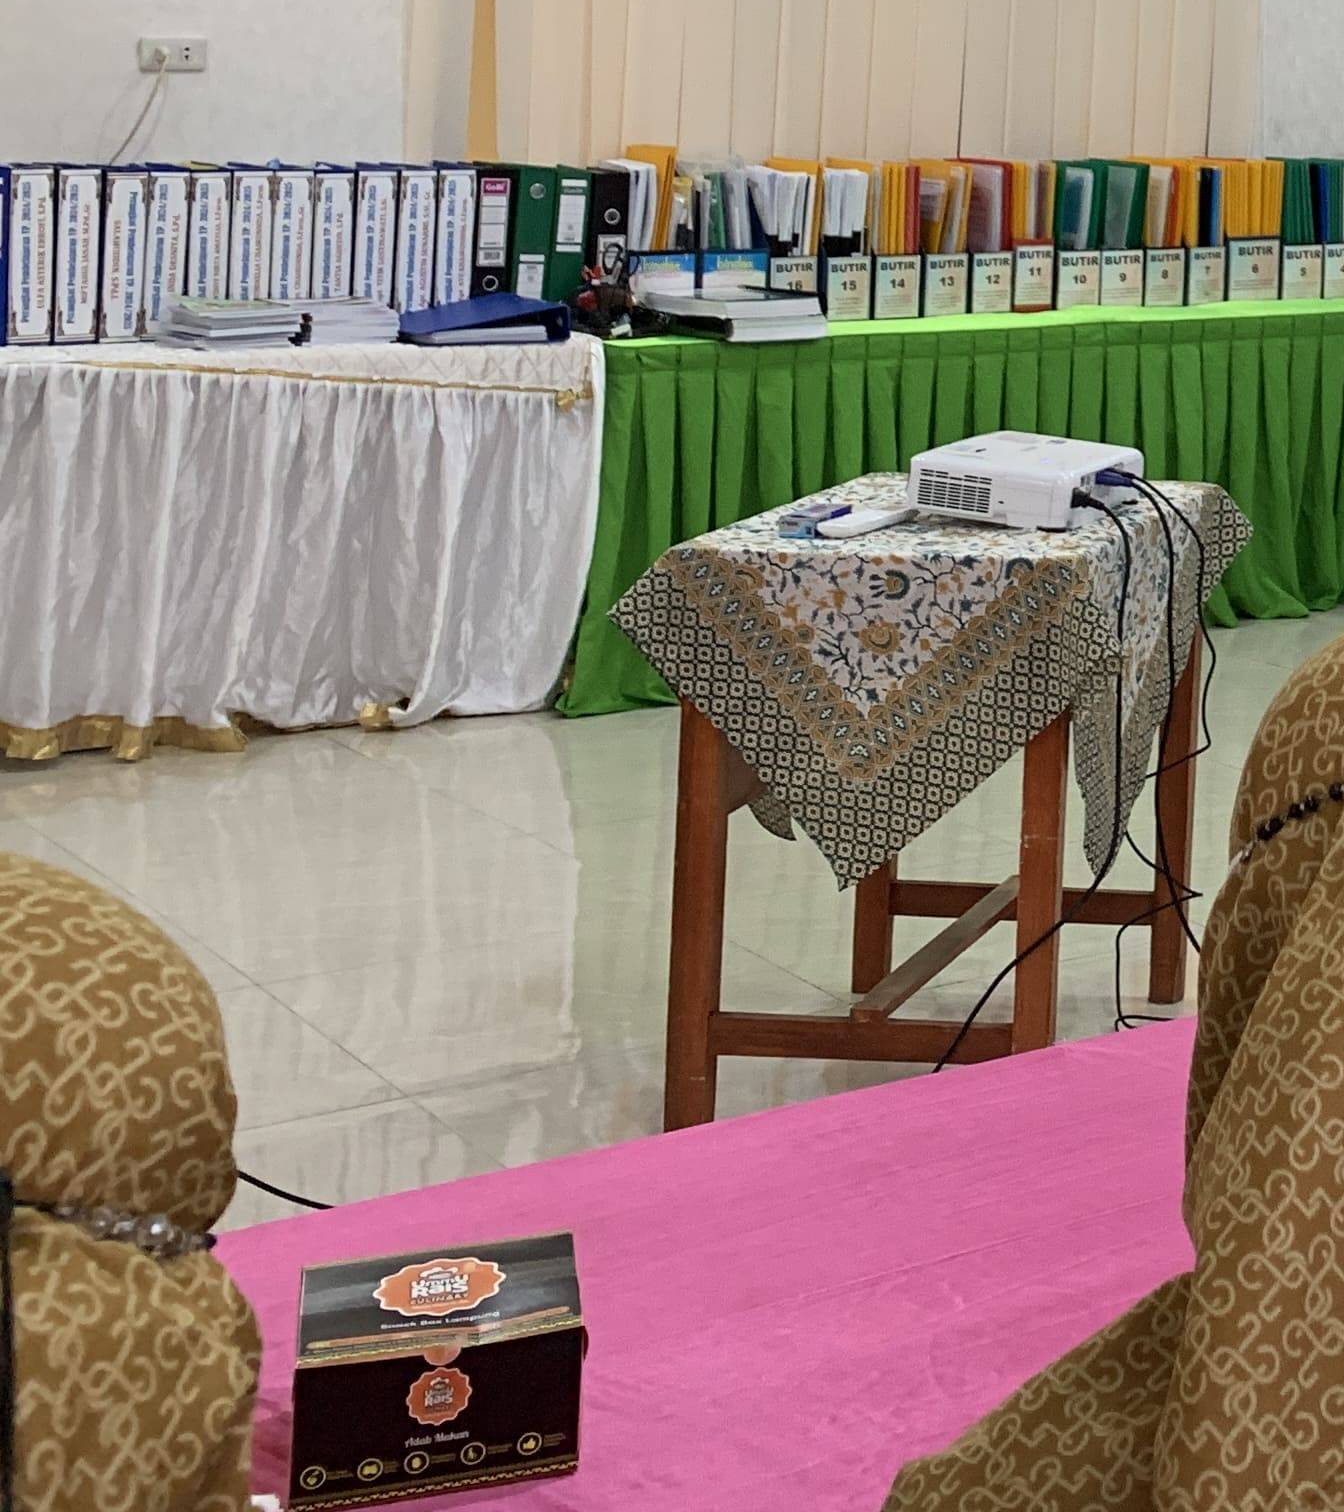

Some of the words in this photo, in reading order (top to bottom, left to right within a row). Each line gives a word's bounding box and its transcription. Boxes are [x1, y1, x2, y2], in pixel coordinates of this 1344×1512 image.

[1019, 250, 1051, 259] BUTIR
[1194, 252, 1222, 260] BUTIR
[1238, 246, 1273, 256] BUTIR
[1286, 249, 1321, 260] BUTIR
[976, 257, 1010, 268] BUTIR
[1062, 256, 1099, 266] BUTIR
[1104, 254, 1141, 265] BUTIR
[1150, 253, 1181, 263] BUTIR
[776, 263, 813, 273] BUTIR
[831, 263, 867, 273] BUTIR
[881, 261, 916, 271] BUTIR
[930, 259, 964, 270] BUTIR
[1028, 267, 1041, 276] 11
[890, 279, 905, 289] 14
[939, 276, 955, 287] 13
[985, 274, 1000, 285] 12
[1073, 274, 1087, 284] 10
[841, 280, 856, 291] 15
